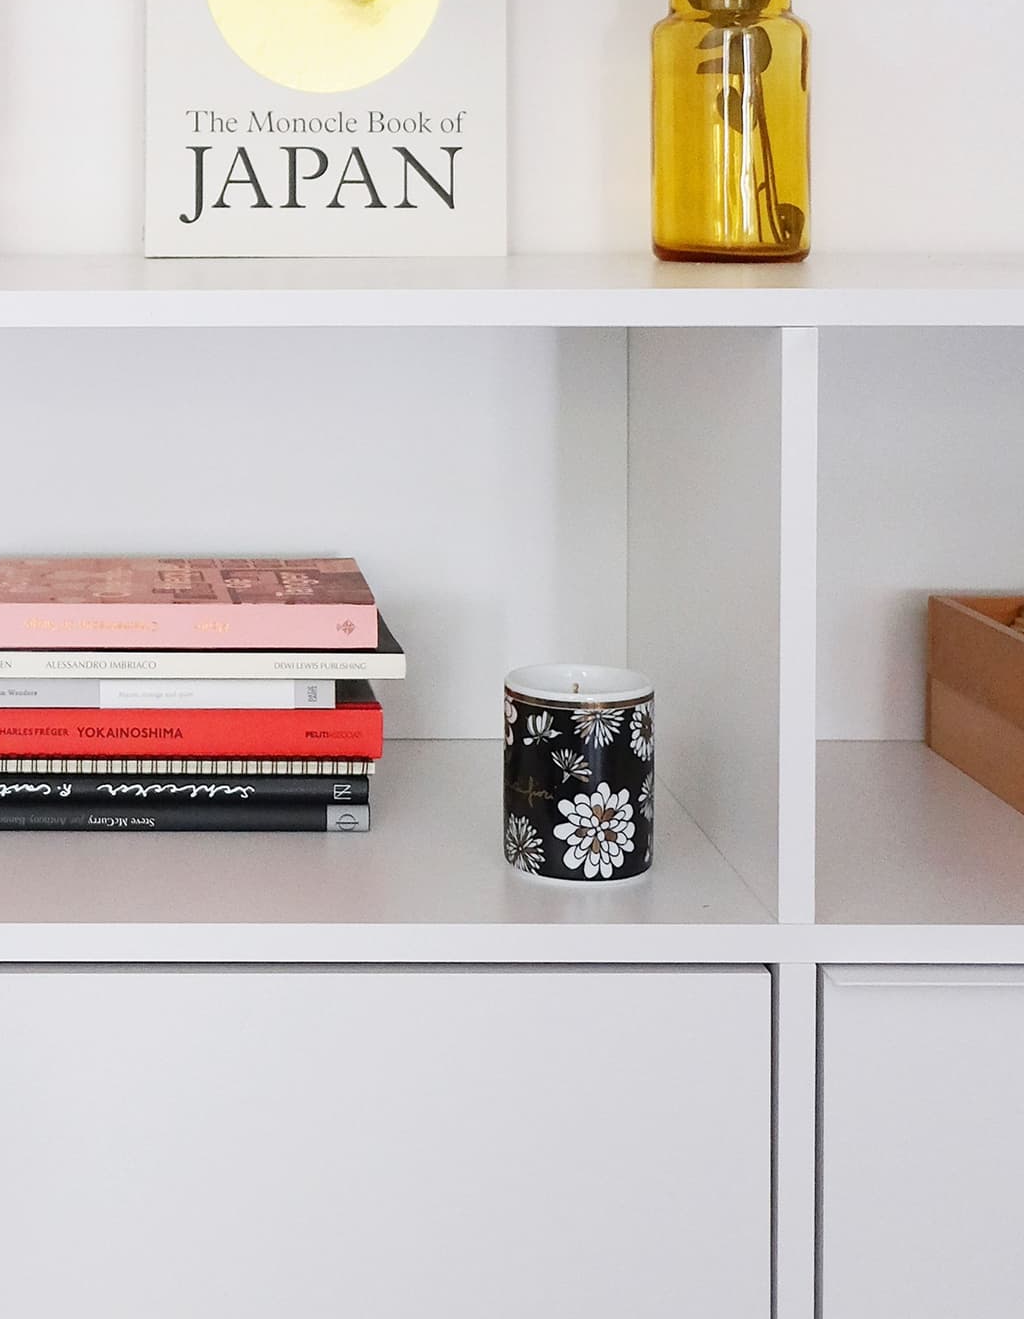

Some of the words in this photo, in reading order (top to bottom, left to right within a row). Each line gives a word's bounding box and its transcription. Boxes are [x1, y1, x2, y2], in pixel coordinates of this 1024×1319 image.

[185, 109, 238, 134] The
[247, 109, 358, 134] Monocle
[367, 109, 433, 134] Book
[439, 109, 467, 134] of
[178, 145, 464, 225] JAPAN
[45, 660, 108, 670] ALESSANDRO
[110, 660, 158, 670] IMBRIACO
[273, 662, 295, 670] DEWI
[297, 662, 318, 670] LEWIS
[320, 662, 367, 671] PUBLISHING
[35, 725, 69, 736] FRÉGER
[76, 727, 184, 739] YOKAINOSHIMA
[57, 783, 72, 797] R.
[87, 815, 129, 827] McCurry
[130, 817, 156, 827] Steve
